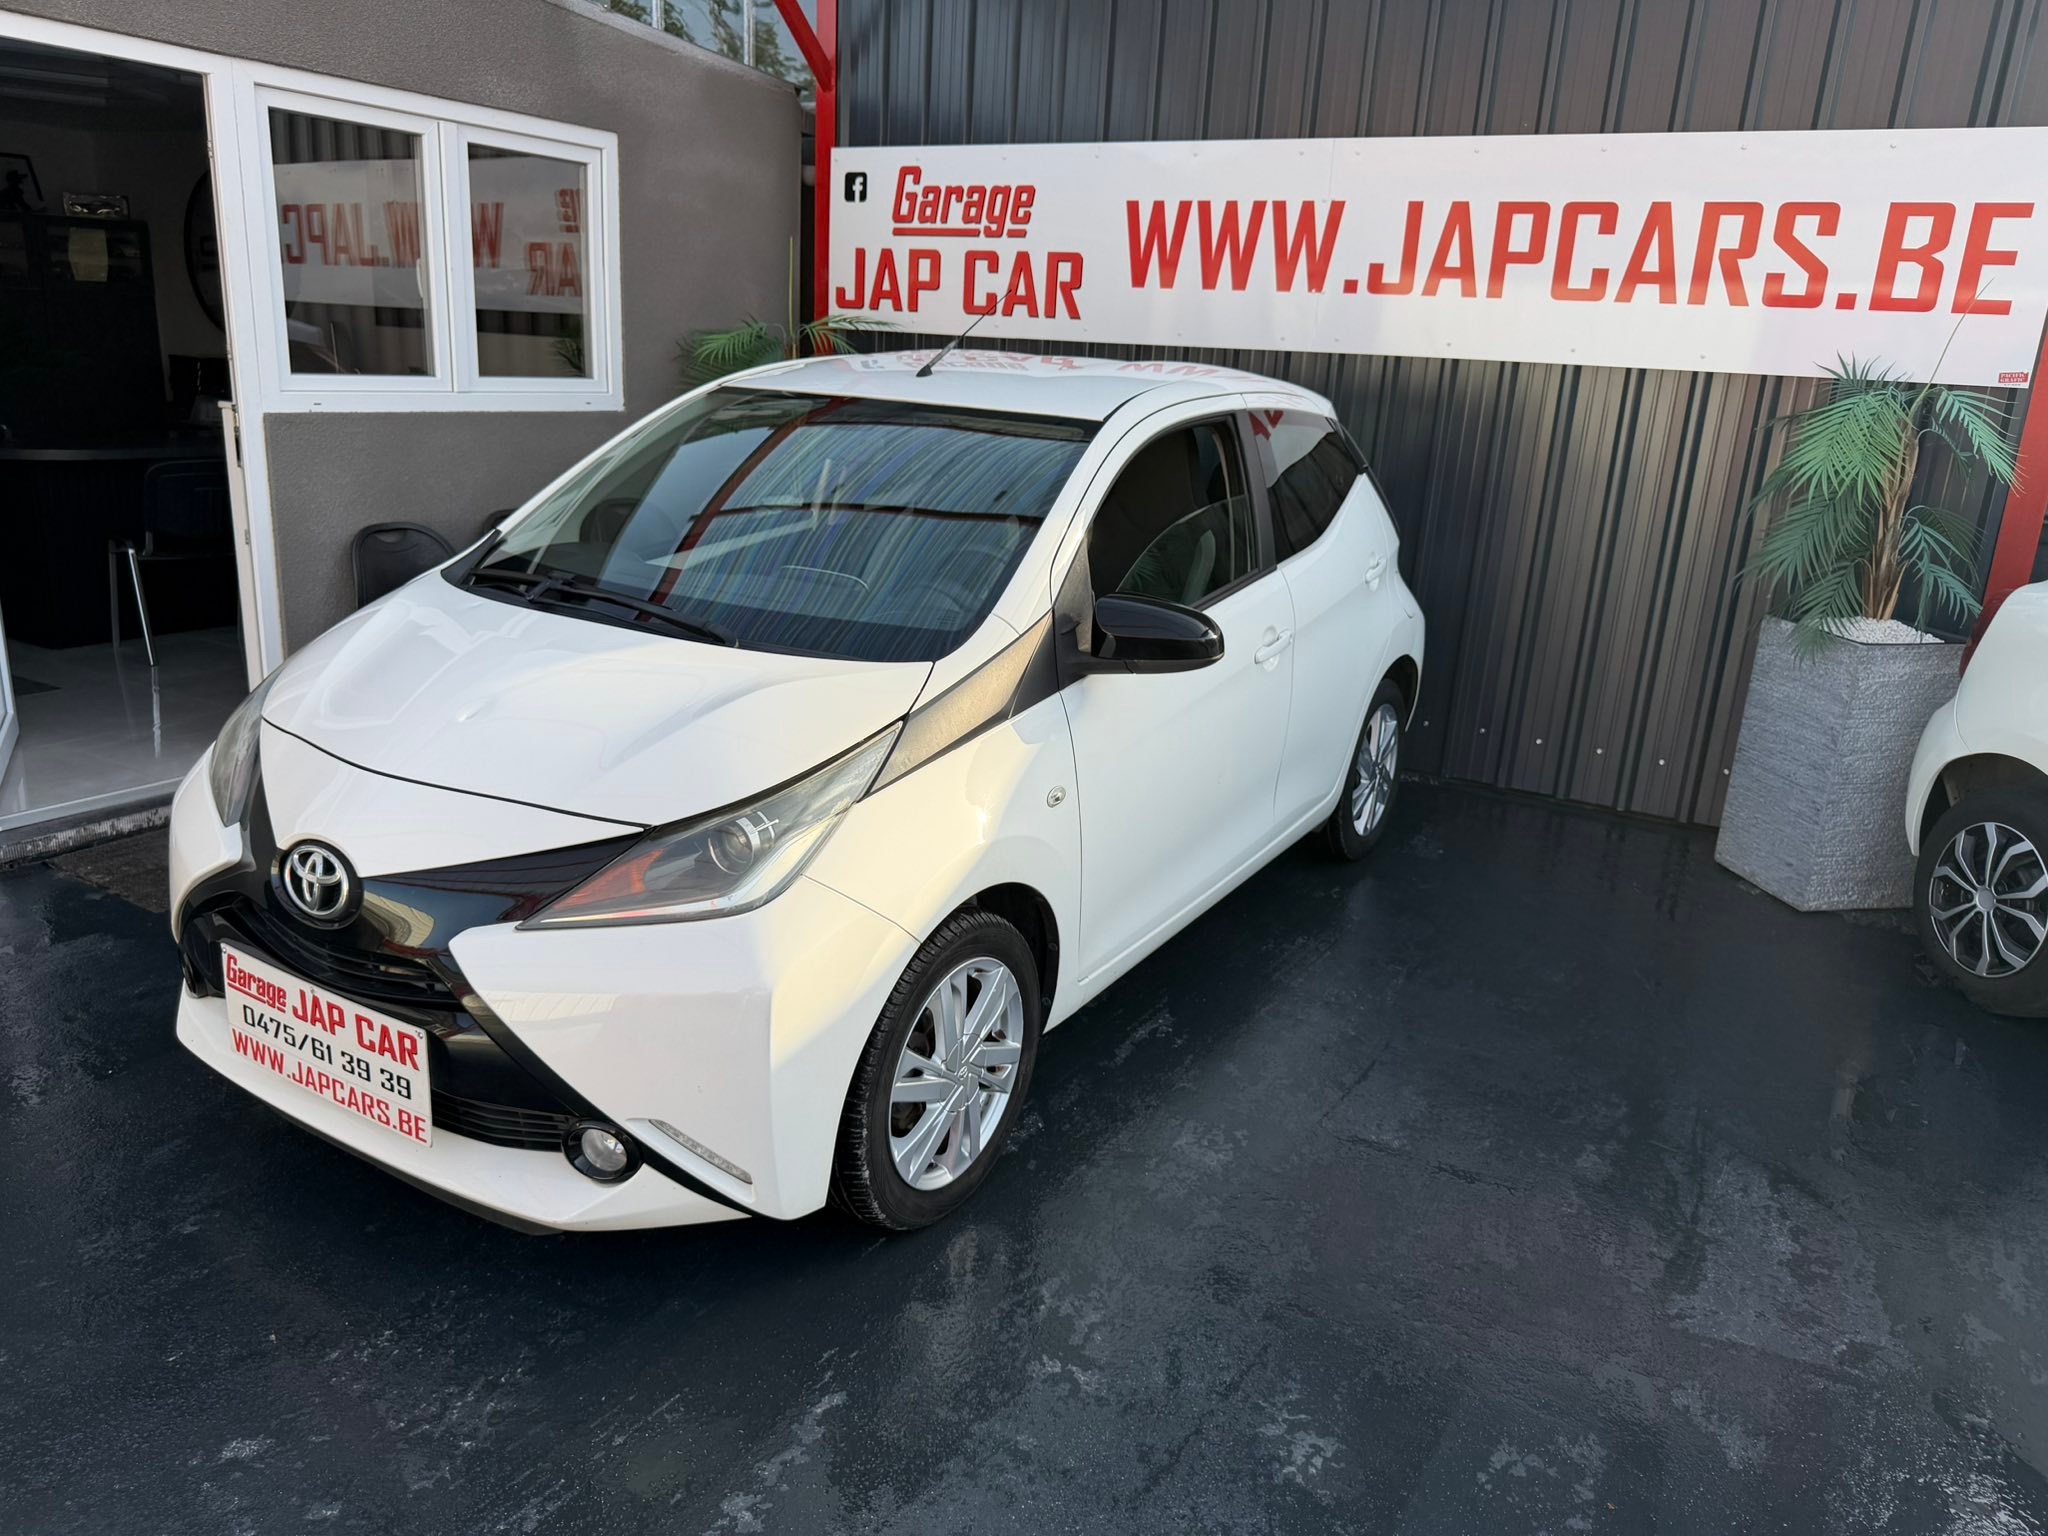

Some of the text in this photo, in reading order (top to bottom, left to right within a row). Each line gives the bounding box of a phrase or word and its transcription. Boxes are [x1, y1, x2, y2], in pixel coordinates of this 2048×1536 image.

[892, 165, 1036, 238] Garage
[835, 247, 1084, 320] JAP CAR
[1126, 199, 2035, 316] WWW.JAPCARS.BE
[226, 953, 421, 1072] Garage JAP CAR
[242, 1004, 412, 1101] 0475/61 39 39
[232, 1028, 428, 1144] WWW.JAPCARS.BE
